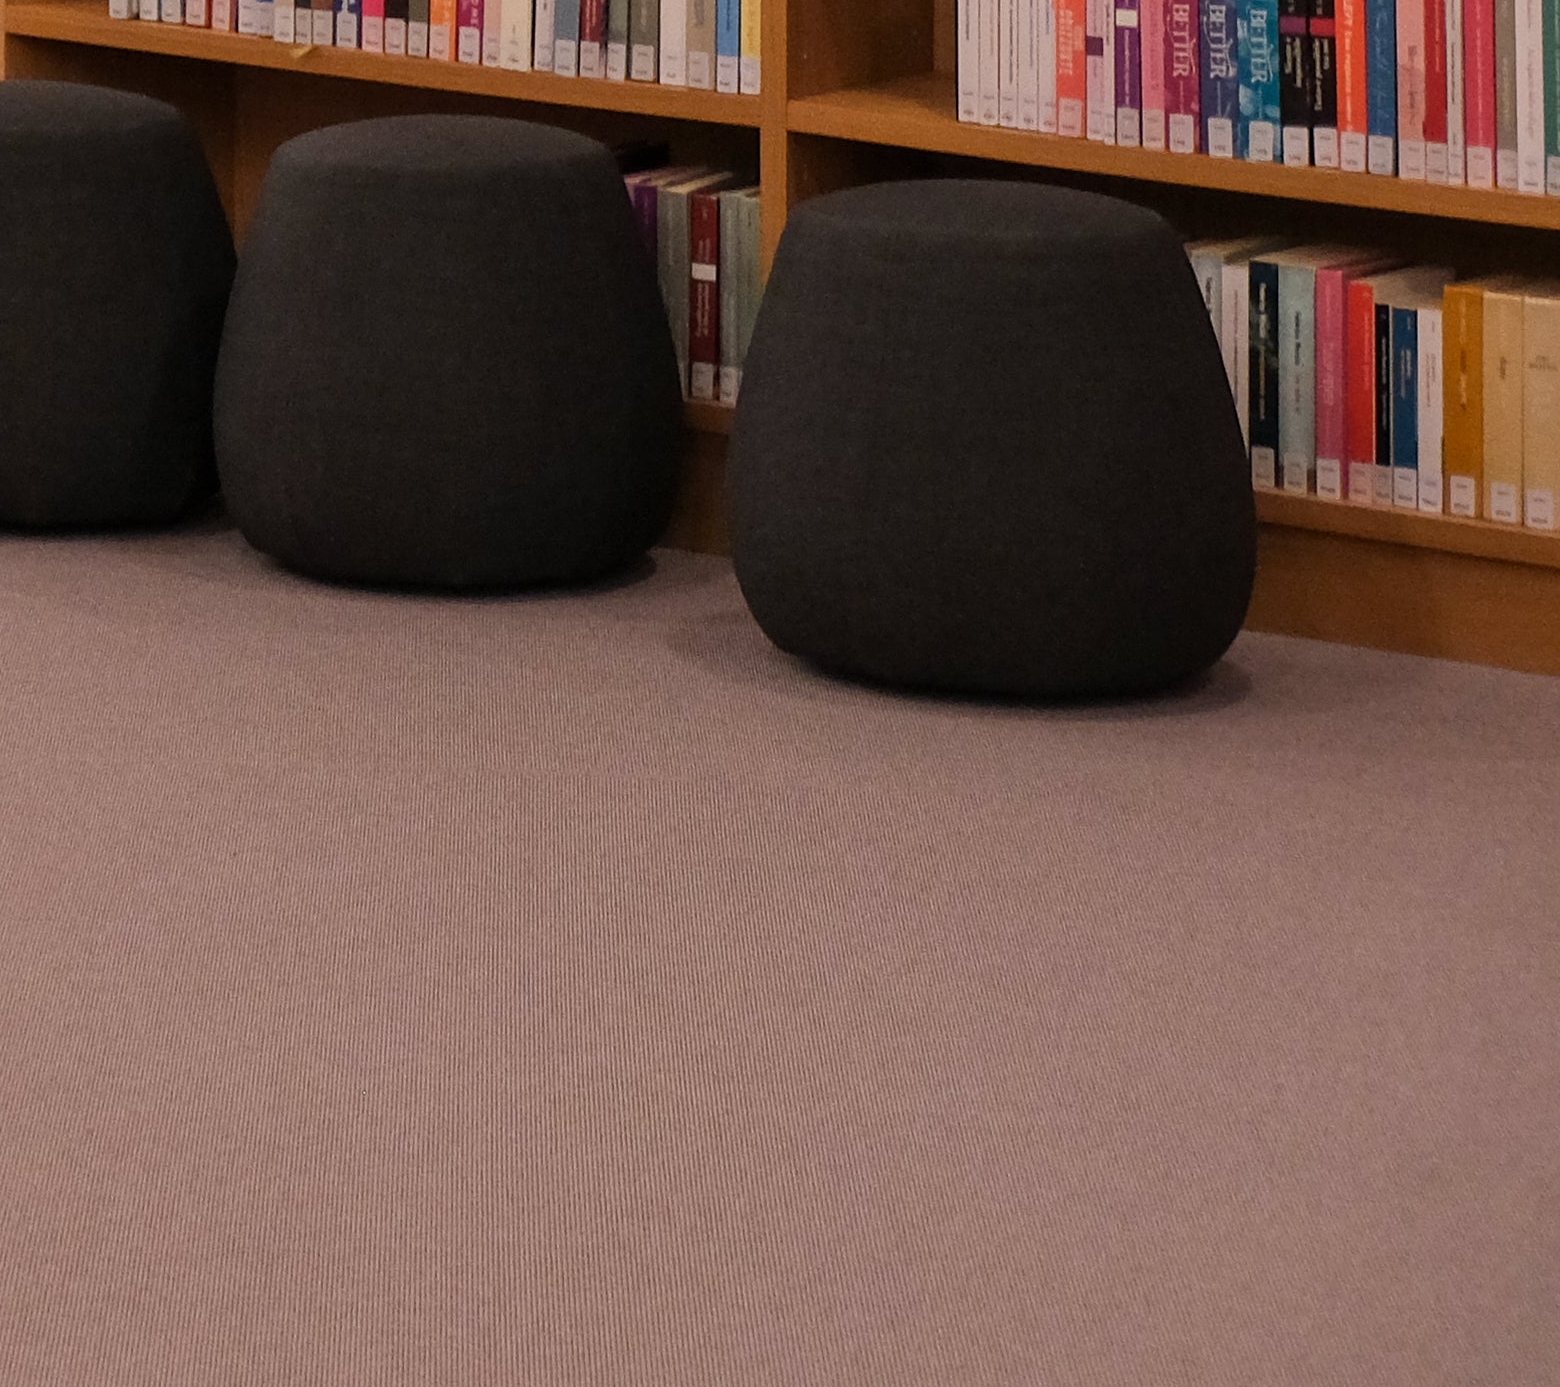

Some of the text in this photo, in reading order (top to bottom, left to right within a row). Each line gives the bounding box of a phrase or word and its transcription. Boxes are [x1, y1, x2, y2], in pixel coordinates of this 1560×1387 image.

[1172, 4, 1190, 77] BETTER
[1208, 4, 1227, 79] BETTER
[1250, 9, 1268, 83] BETTER
